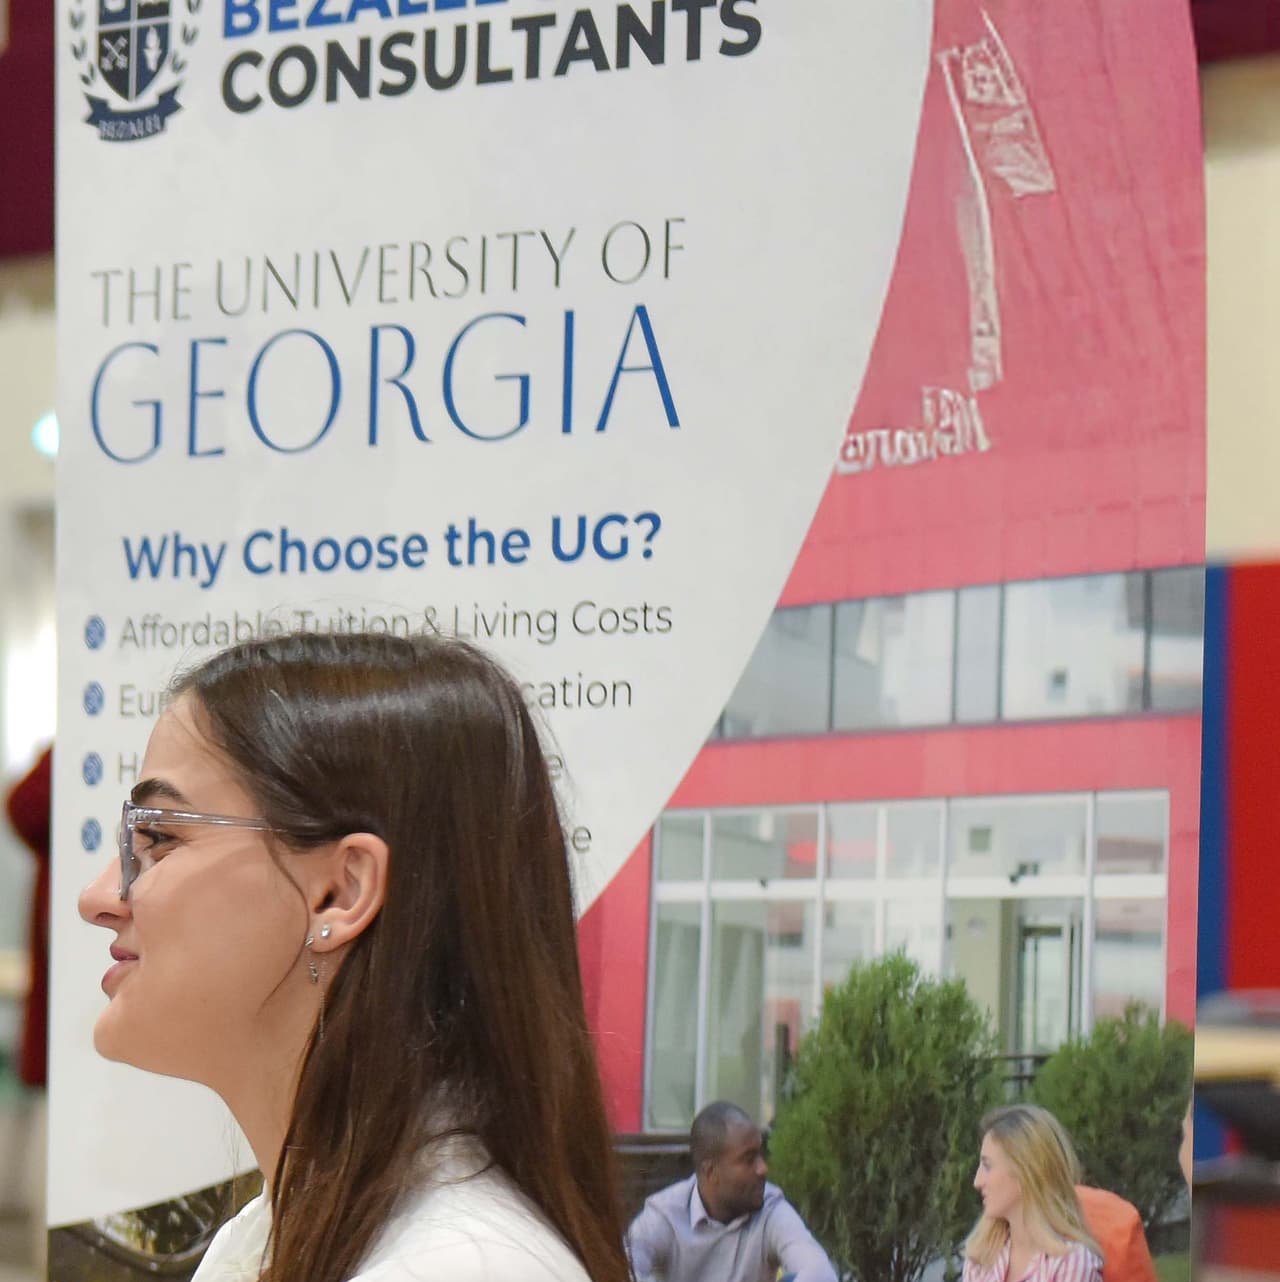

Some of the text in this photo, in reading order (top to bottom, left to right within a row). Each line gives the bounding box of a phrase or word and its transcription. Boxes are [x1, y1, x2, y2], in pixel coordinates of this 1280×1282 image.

[222, 0, 762, 113] CONSULTANTS
[90, 217, 687, 327] THE UNIVERSITY OF
[89, 303, 681, 464] GEORGIA
[122, 511, 663, 589] Why Choose the UG?
[119, 610, 284, 648] Affordable
[454, 601, 558, 646] Living
[572, 599, 673, 635] Costs
